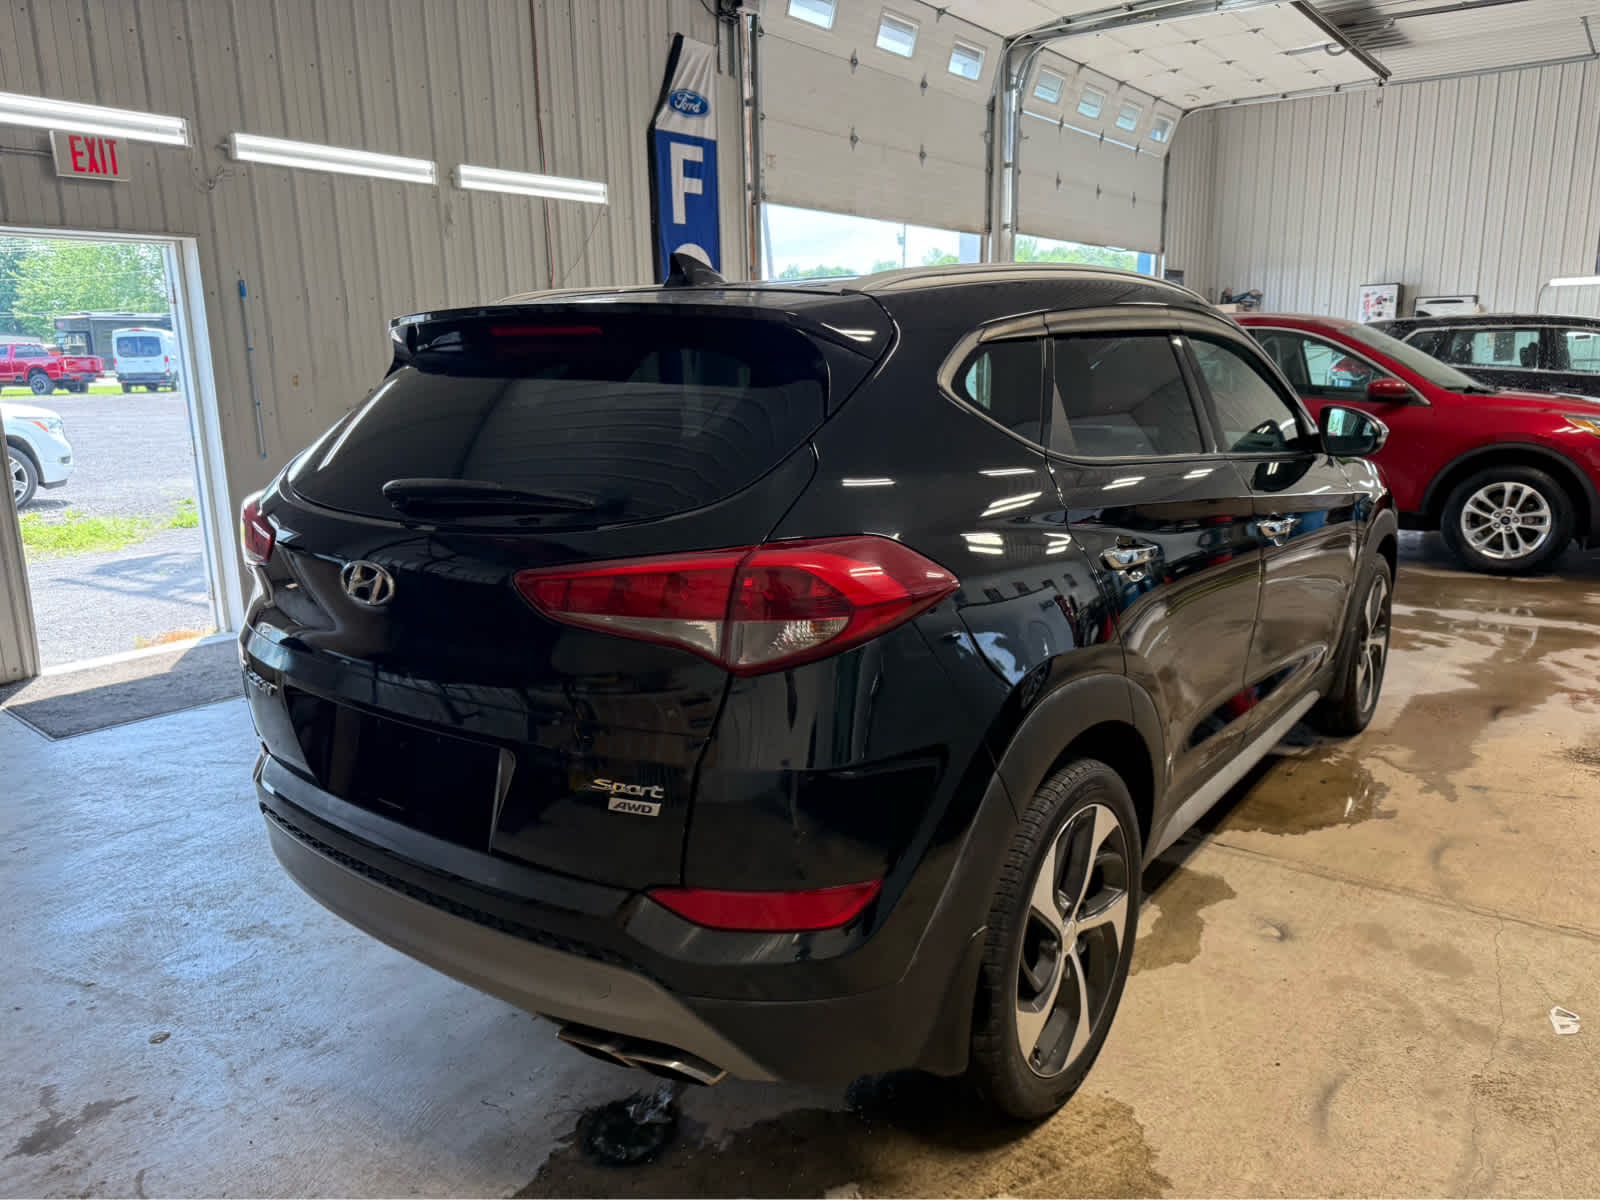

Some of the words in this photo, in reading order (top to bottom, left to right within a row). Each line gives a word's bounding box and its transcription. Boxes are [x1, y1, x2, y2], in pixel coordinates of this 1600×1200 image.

[673, 92, 703, 114] Ford
[68, 135, 119, 175] EXIT
[591, 778, 664, 799] Sport
[613, 801, 653, 814] AWD
